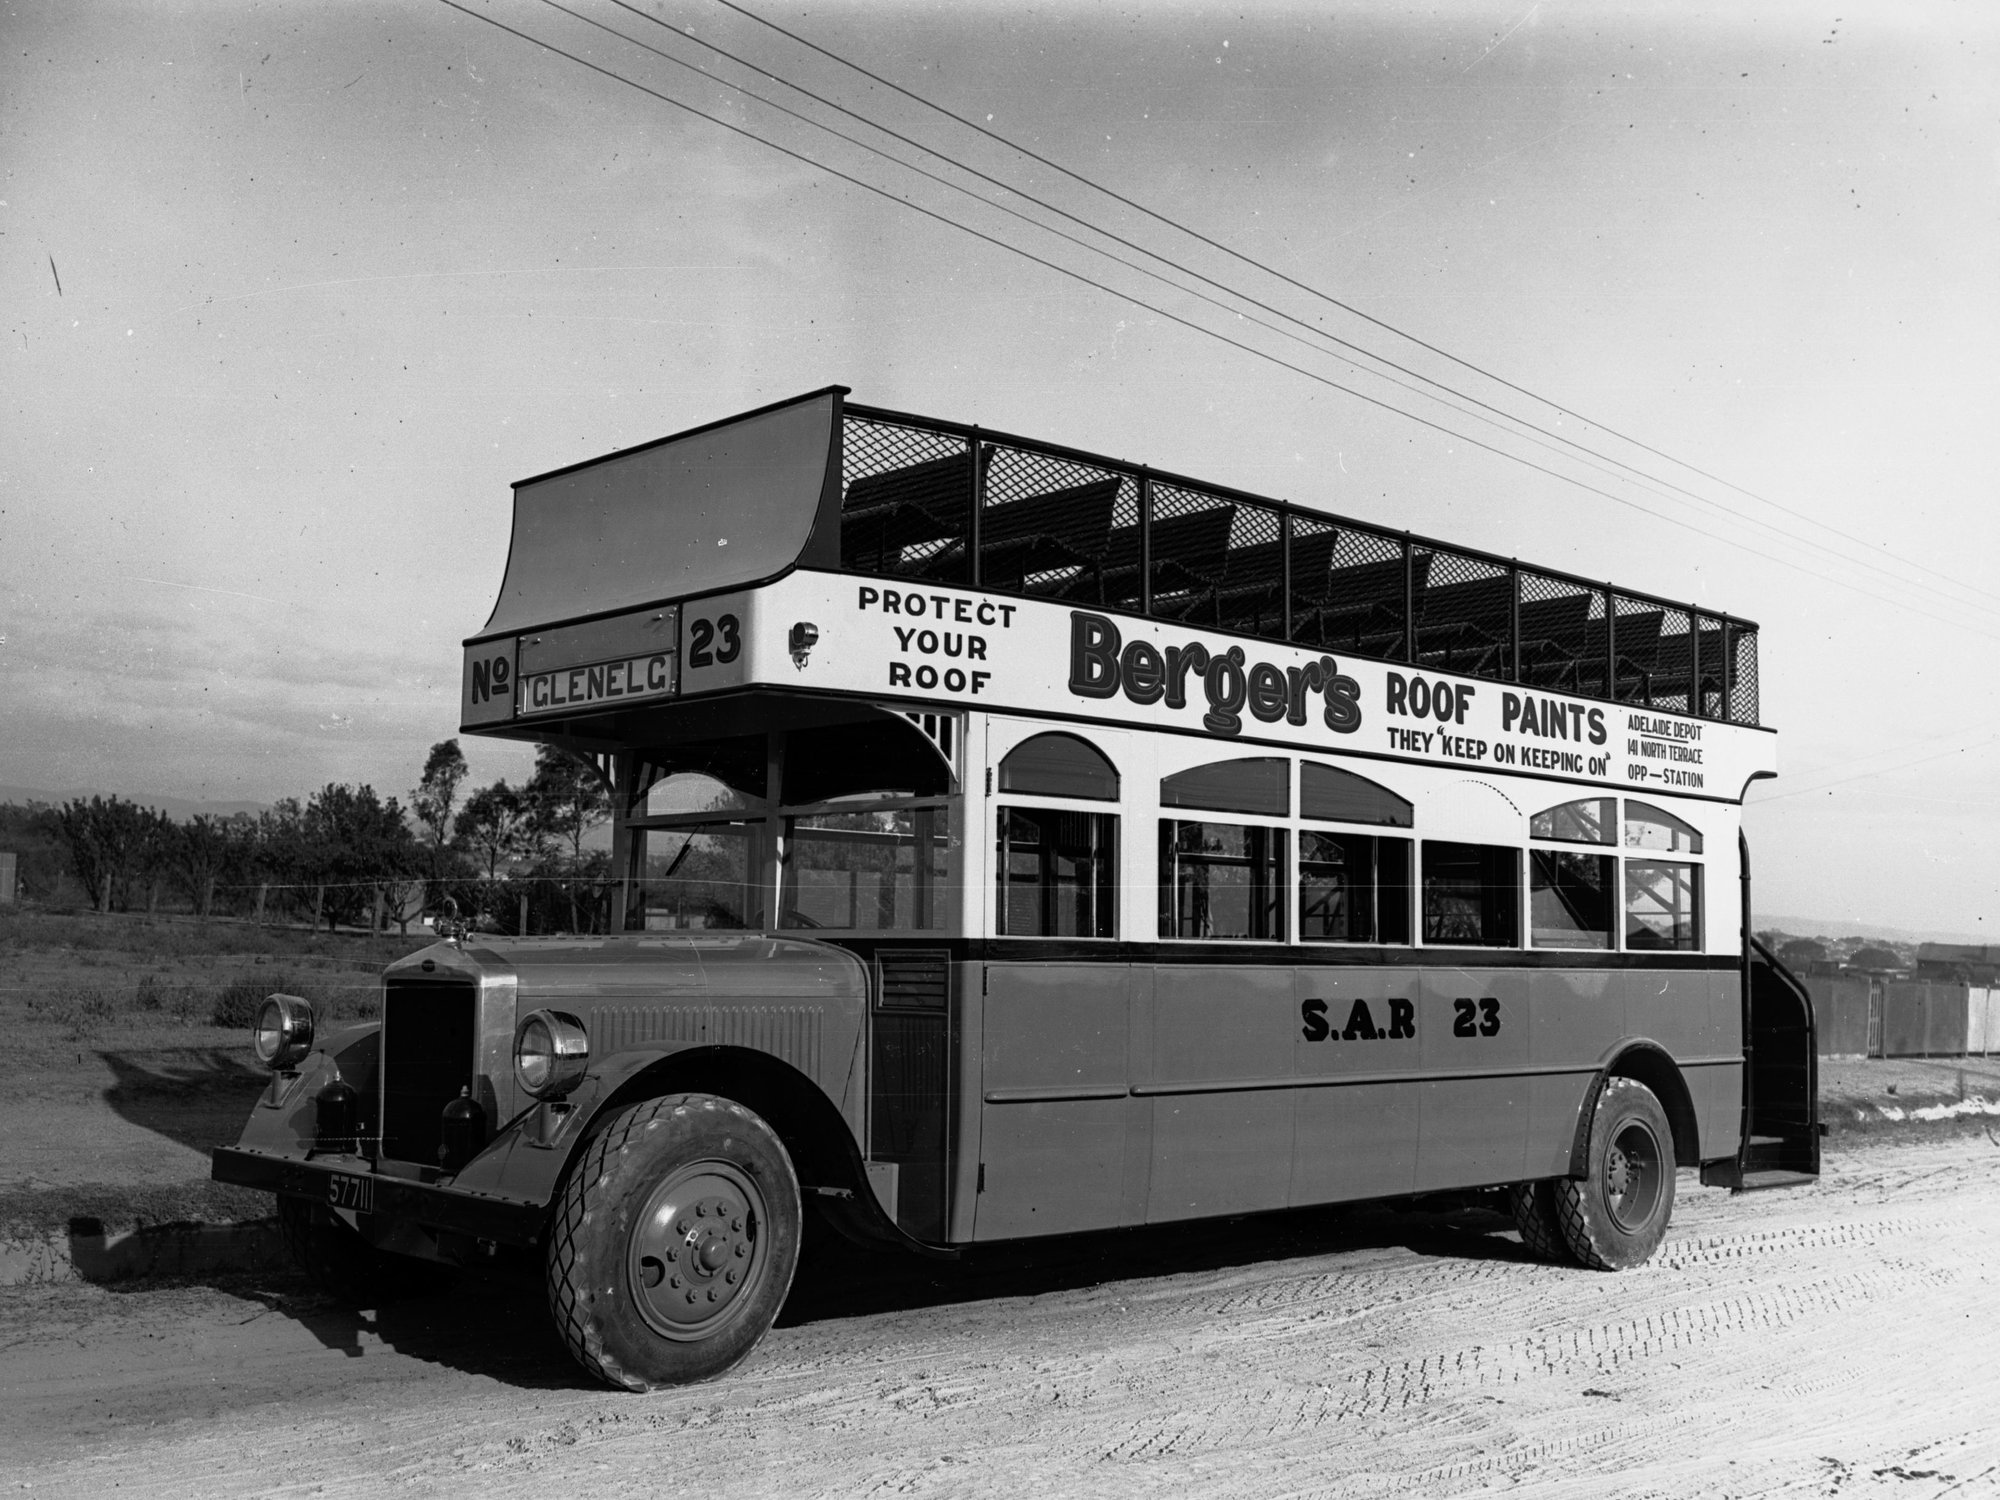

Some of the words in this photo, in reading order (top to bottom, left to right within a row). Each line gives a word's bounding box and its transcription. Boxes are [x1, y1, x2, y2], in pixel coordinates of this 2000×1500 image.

[859, 586, 1016, 628] PROTECT
[689, 613, 741, 669] 23
[893, 626, 987, 660] YOUR
[532, 655, 666, 707] GLENELG
[889, 661, 991, 694] ROOF
[1068, 610, 1362, 736] Berger's
[1386, 671, 1475, 725] ROOF
[1502, 691, 1607, 745] PAINTS
[1628, 714, 1672, 736] ADELAIDE
[1674, 721, 1703, 740] DEPOT
[1387, 727, 1434, 753] THEY
[1494, 743, 1515, 765] ON
[1521, 746, 1583, 773] KEEPING
[1641, 740, 1667, 759] NORTH
[1668, 744, 1703, 765] TERRACE
[1301, 998, 1415, 1042] S.A.R
[1453, 997, 1500, 1037] 23
